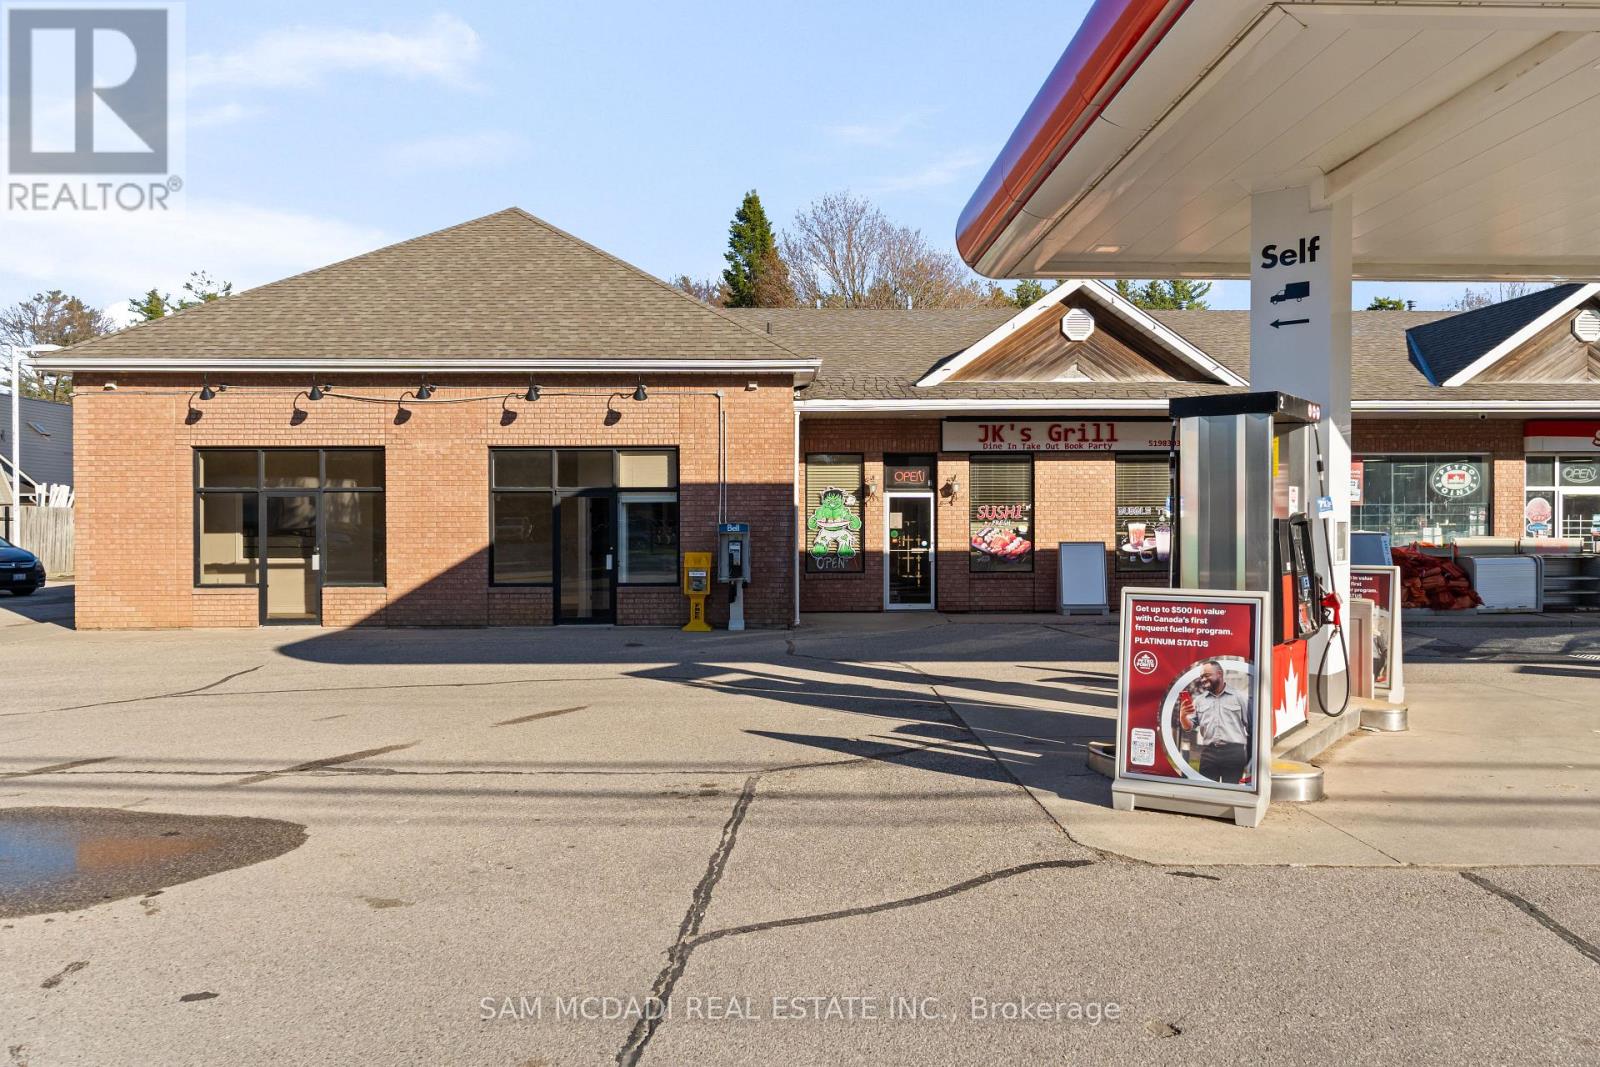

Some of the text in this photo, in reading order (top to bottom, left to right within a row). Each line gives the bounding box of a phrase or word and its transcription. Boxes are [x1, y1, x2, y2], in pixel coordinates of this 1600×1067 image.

[1261, 236, 1320, 269] Self
[1279, 395, 1284, 409] 2
[978, 423, 1119, 443] JK's Grill
[1088, 443, 1113, 451] Party
[894, 470, 925, 482] OPEN
[1439, 465, 1475, 475] PETRO
[1564, 467, 1597, 480] OPEN
[1435, 483, 1476, 496] POINTS
[976, 503, 1023, 520] SUSHI
[726, 524, 740, 532] Bell
[816, 557, 845, 570] OPEN
[1135, 605, 1150, 613] Get
[1171, 606, 1193, 614] $500
[1193, 607, 1202, 615] in
[1135, 614, 1208, 625] with Canada's first
[1134, 624, 1233, 636] frequent fueller program.
[1134, 637, 1209, 647] PLATINUM STATUS
